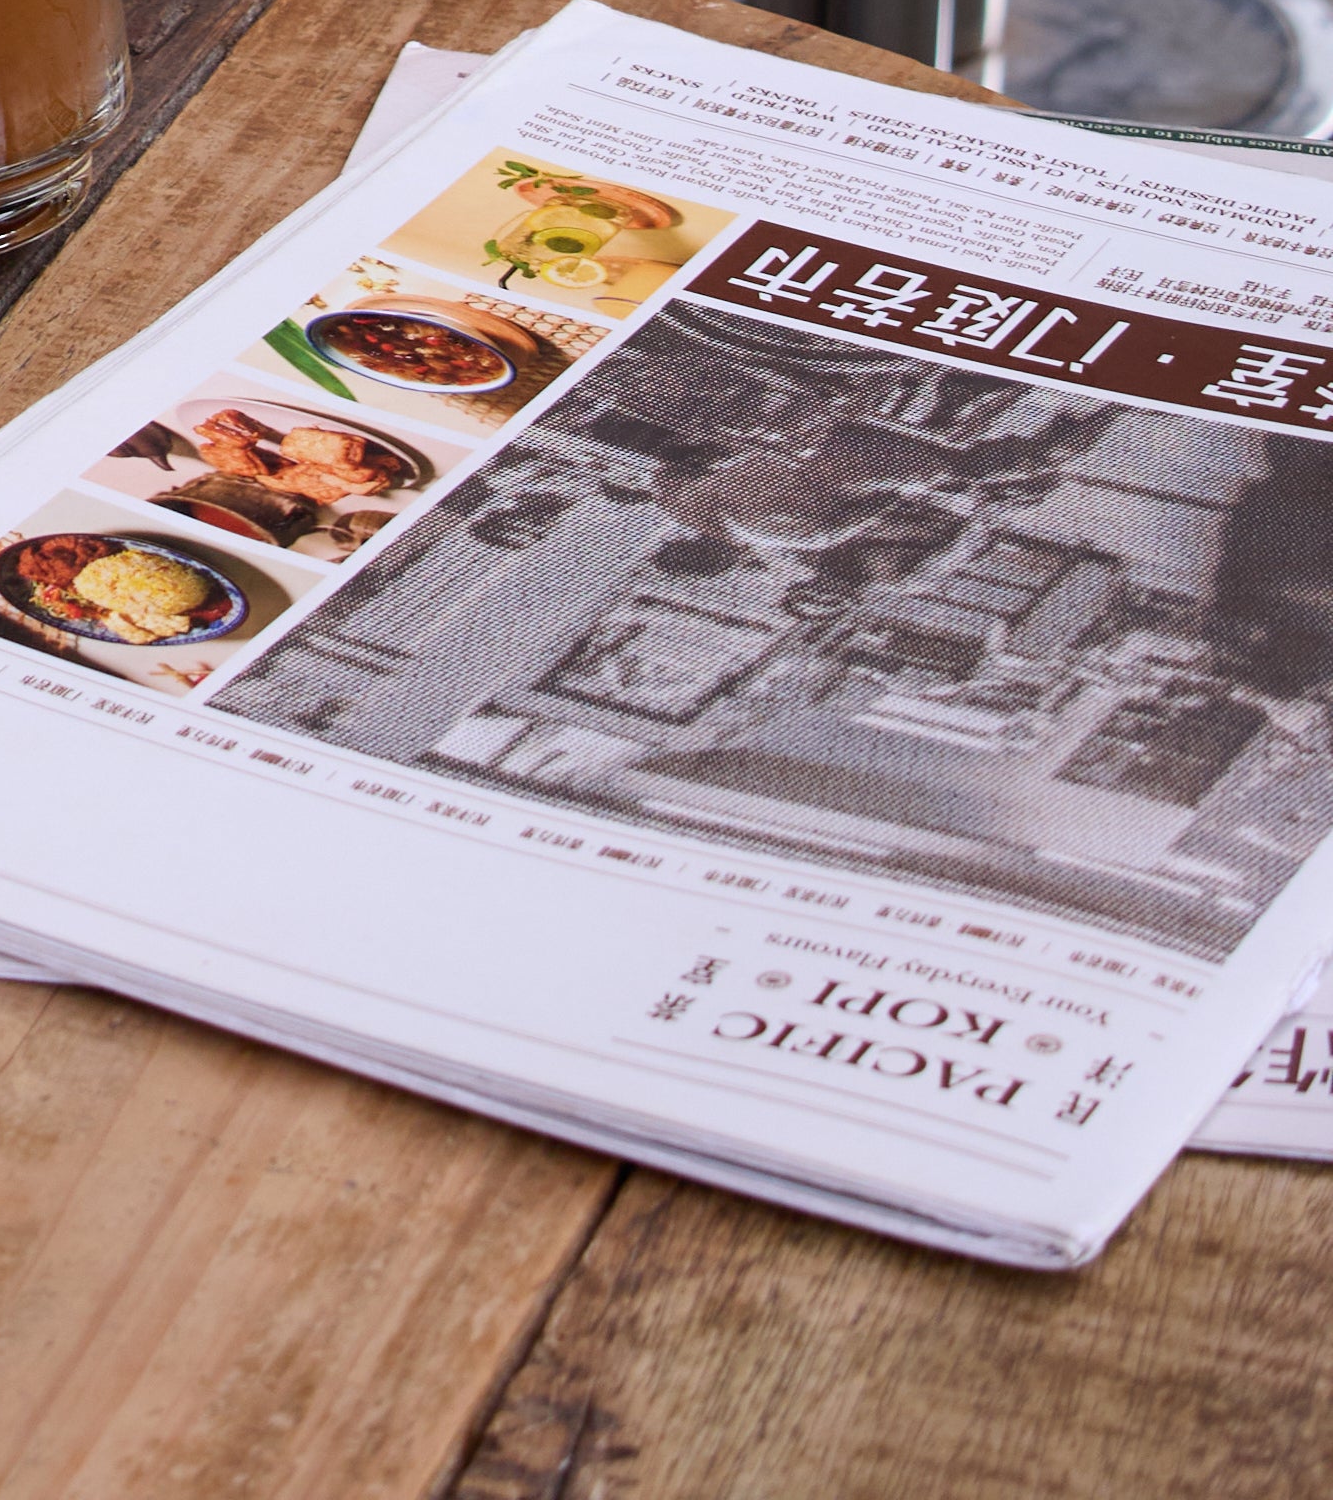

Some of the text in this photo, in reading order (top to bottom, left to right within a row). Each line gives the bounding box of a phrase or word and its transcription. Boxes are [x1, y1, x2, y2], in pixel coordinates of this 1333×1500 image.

[747, 87, 817, 107] DRINKS
[525, 121, 553, 133] Shu
[586, 119, 621, 133] Mint
[849, 111, 915, 128] SERIES
[534, 113, 659, 152] Chrysanthemum
[558, 132, 585, 144] Lou
[625, 131, 663, 143] Lime
[1155, 130, 1172, 139] to
[1179, 132, 1241, 146] subject
[591, 143, 626, 155] Char
[631, 65, 1304, 232] HANDMADE NOODLES CLASSIC LOCAL FOOD WOK FRIED SNACKS
[667, 142, 706, 155] Plum
[919, 127, 1026, 156] BREAKFAST
[1248, 139, 1302, 152] prices
[1308, 143, 1333, 156] All
[562, 144, 623, 163] Briyani
[632, 149, 680, 169] Pacific
[661, 151, 710, 166] Pacific
[709, 153, 745, 165] Sour
[636, 160, 668, 177] Rice
[720, 164, 776, 184] Noodle,
[749, 163, 797, 179] Pacific
[1046, 159, 1106, 177] TOAST
[671, 174, 725, 192] Briyani
[693, 139, 1083, 240] Pacific Hor Ka Sai, Pacific Fried Rice Cake, Yam Cake
[736, 181, 769, 192] Mee
[783, 182, 823, 196] Fried
[804, 175, 861, 195] Dessert,
[728, 189, 778, 206] Pacific
[775, 190, 803, 201] Pan
[833, 194, 876, 209] Lamb
[866, 192, 921, 210] Fungus
[1140, 181, 1236, 207] DESSERTS
[783, 202, 836, 222] Tender,
[810, 199, 846, 212] Mala
[1239, 204, 1316, 224] PACIFIC
[853, 210, 913, 229] Chicken
[925, 208, 967, 221] Snow
[843, 218, 903, 238] Chicken
[990, 223, 1025, 236] Gum
[907, 235, 958, 253] Lemak
[920, 227, 1002, 253] Mushroom
[974, 230, 1025, 247] Pacific
[1031, 233, 1075, 249] Peach
[961, 249, 996, 262] Nasi
[1008, 250, 1058, 266] Pacific
[1036, 245, 1067, 258] Fen,
[1000, 259, 1050, 275] Pacific
[1107, 267, 1144, 281] 民洋
[728, 246, 1130, 373] 门庭若市
[650, 956, 728, 1022] 茶室
[765, 934, 1108, 1027] Your Everyday Flavours
[812, 981, 1005, 1044] KOPI
[713, 1014, 1024, 1106] PACIFIC
[1056, 1056, 1132, 1126] 民洋
